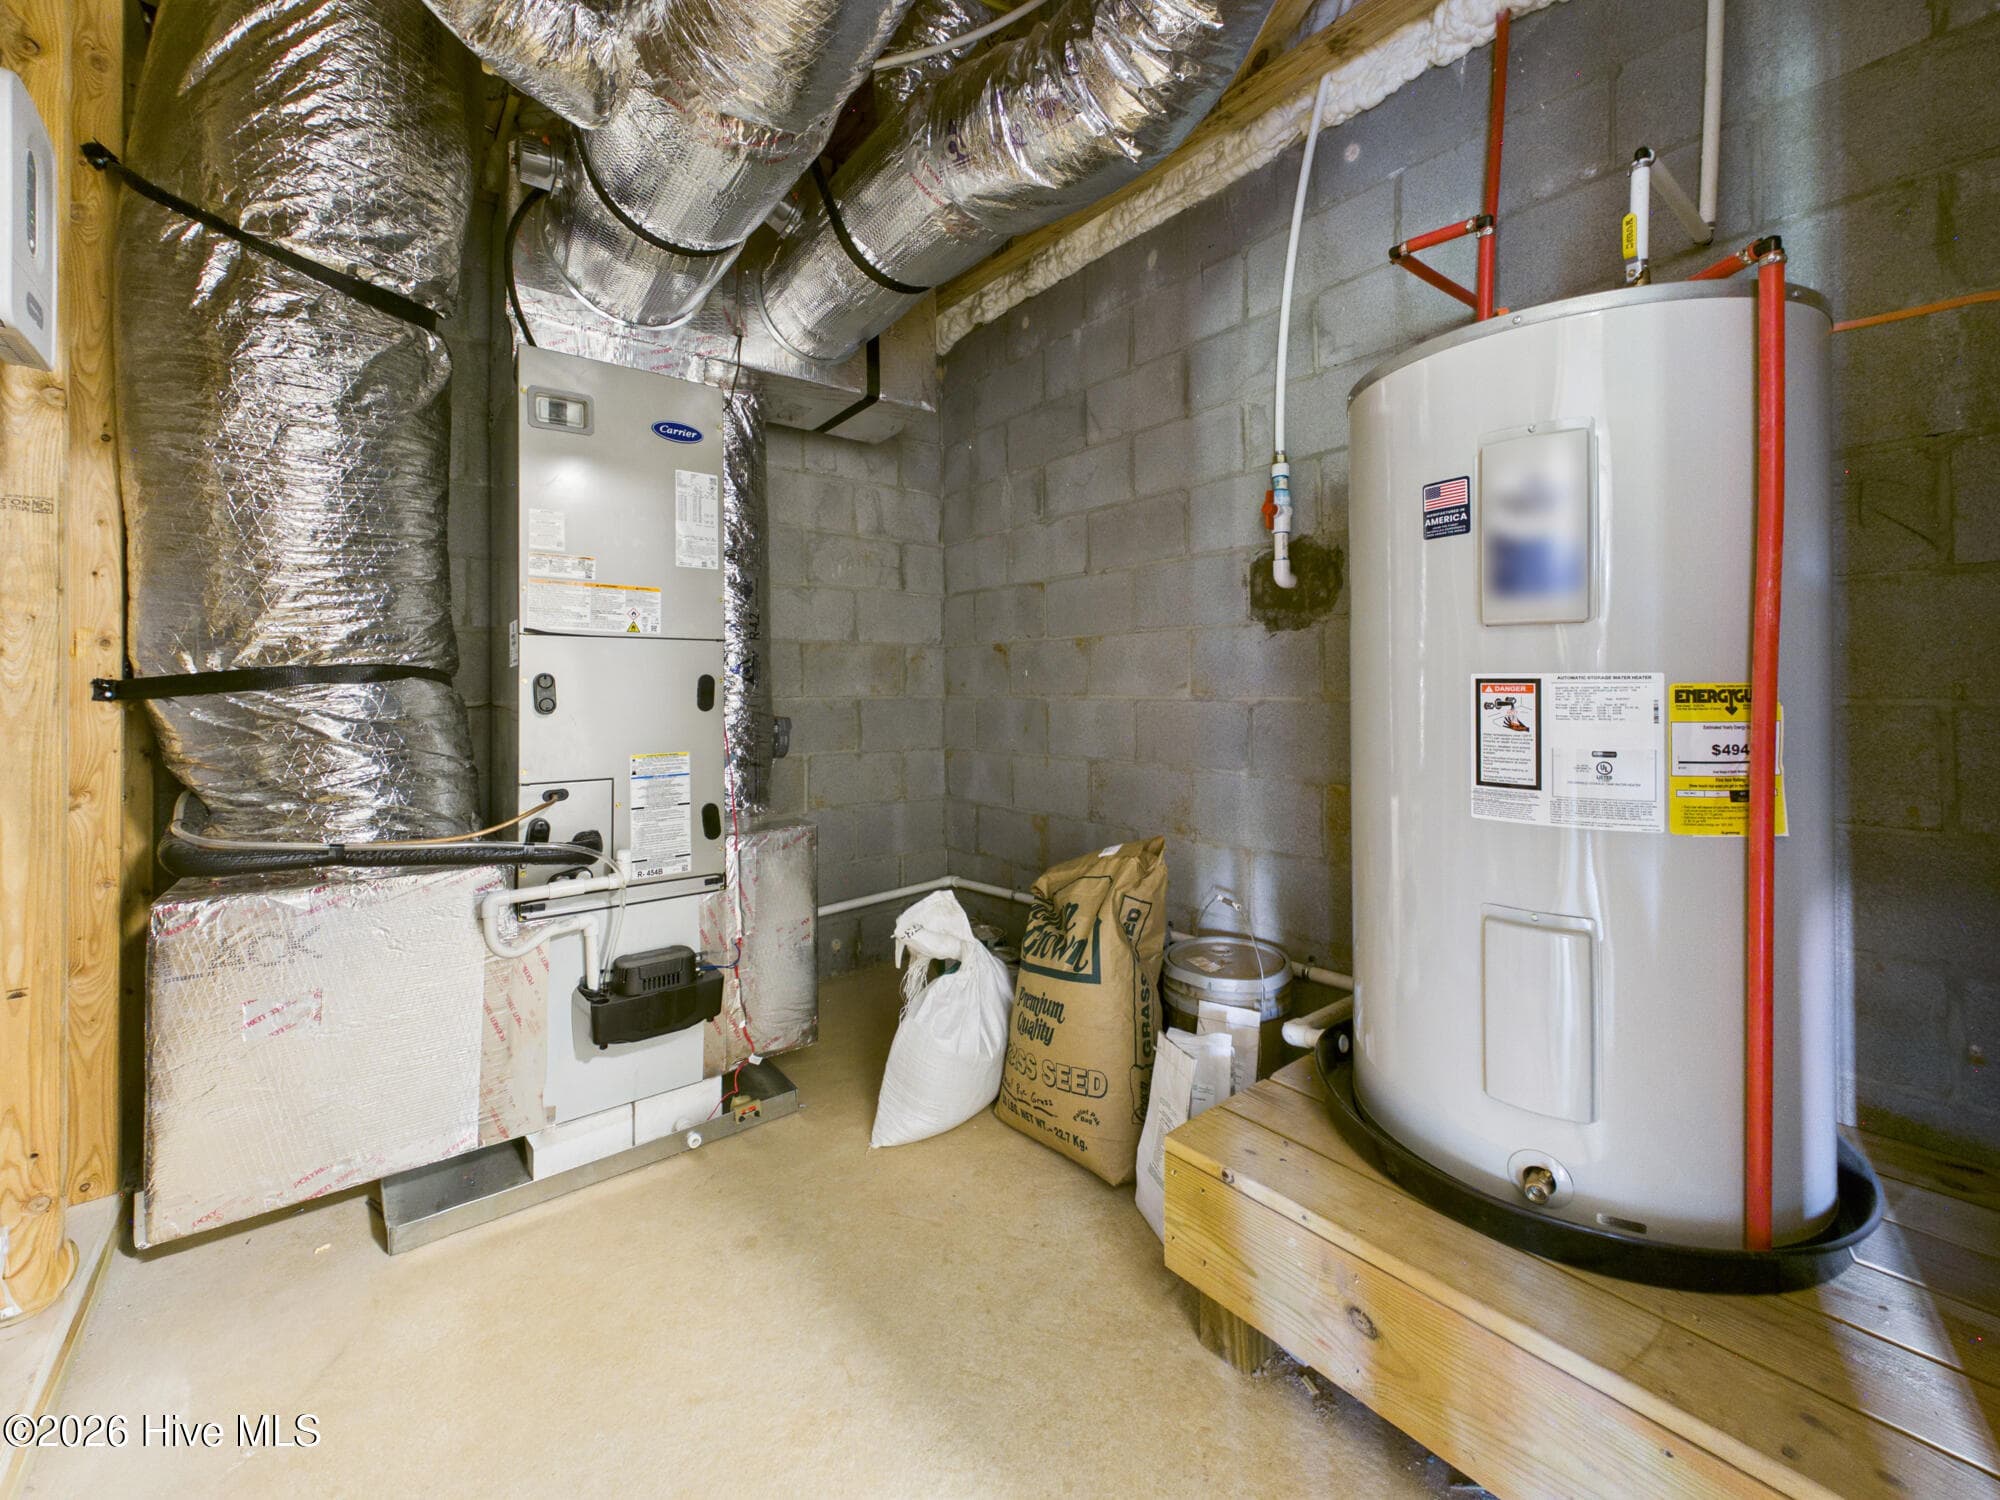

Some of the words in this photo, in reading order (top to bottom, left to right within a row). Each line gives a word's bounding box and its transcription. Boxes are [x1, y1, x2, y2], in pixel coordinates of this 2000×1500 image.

[659, 424, 698, 438] Carrier
[1425, 513, 1468, 527] AMERICA
[1494, 684, 1527, 692] DANGER
[1711, 743, 1750, 757] $494
[647, 868, 663, 877] 454B
[1017, 986, 1065, 1024] Premium
[1017, 1011, 1054, 1046] Quality
[1041, 1058, 1108, 1099] SEED
[1020, 1108, 1034, 1124] NET
